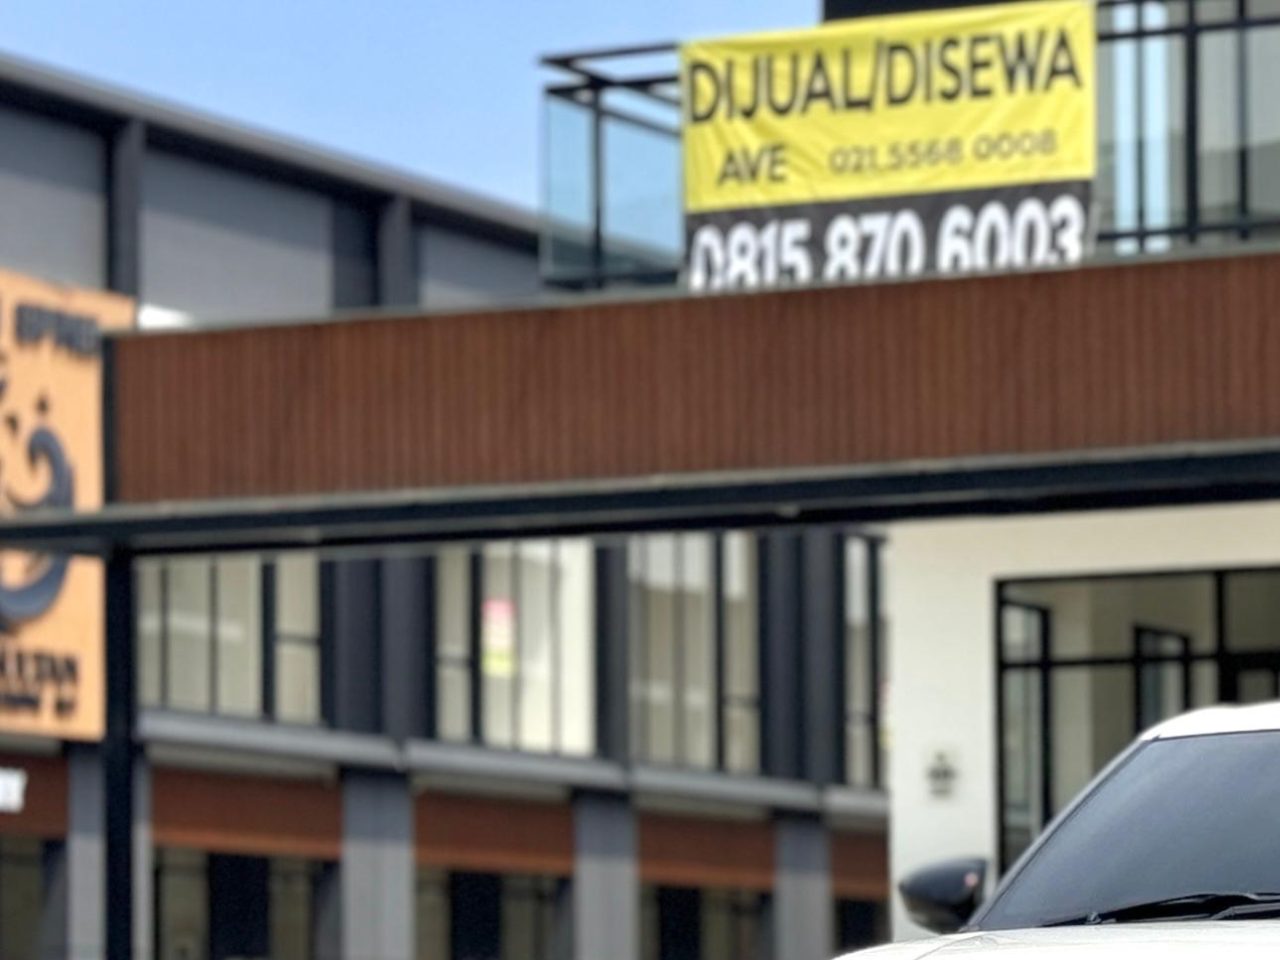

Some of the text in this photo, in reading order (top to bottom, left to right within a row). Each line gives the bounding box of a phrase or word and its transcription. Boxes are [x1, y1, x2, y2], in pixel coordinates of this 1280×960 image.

[688, 29, 1082, 123] DIJUAL/DISEWA
[717, 144, 788, 186] AVE
[690, 196, 1084, 291] 0815 870 6003
